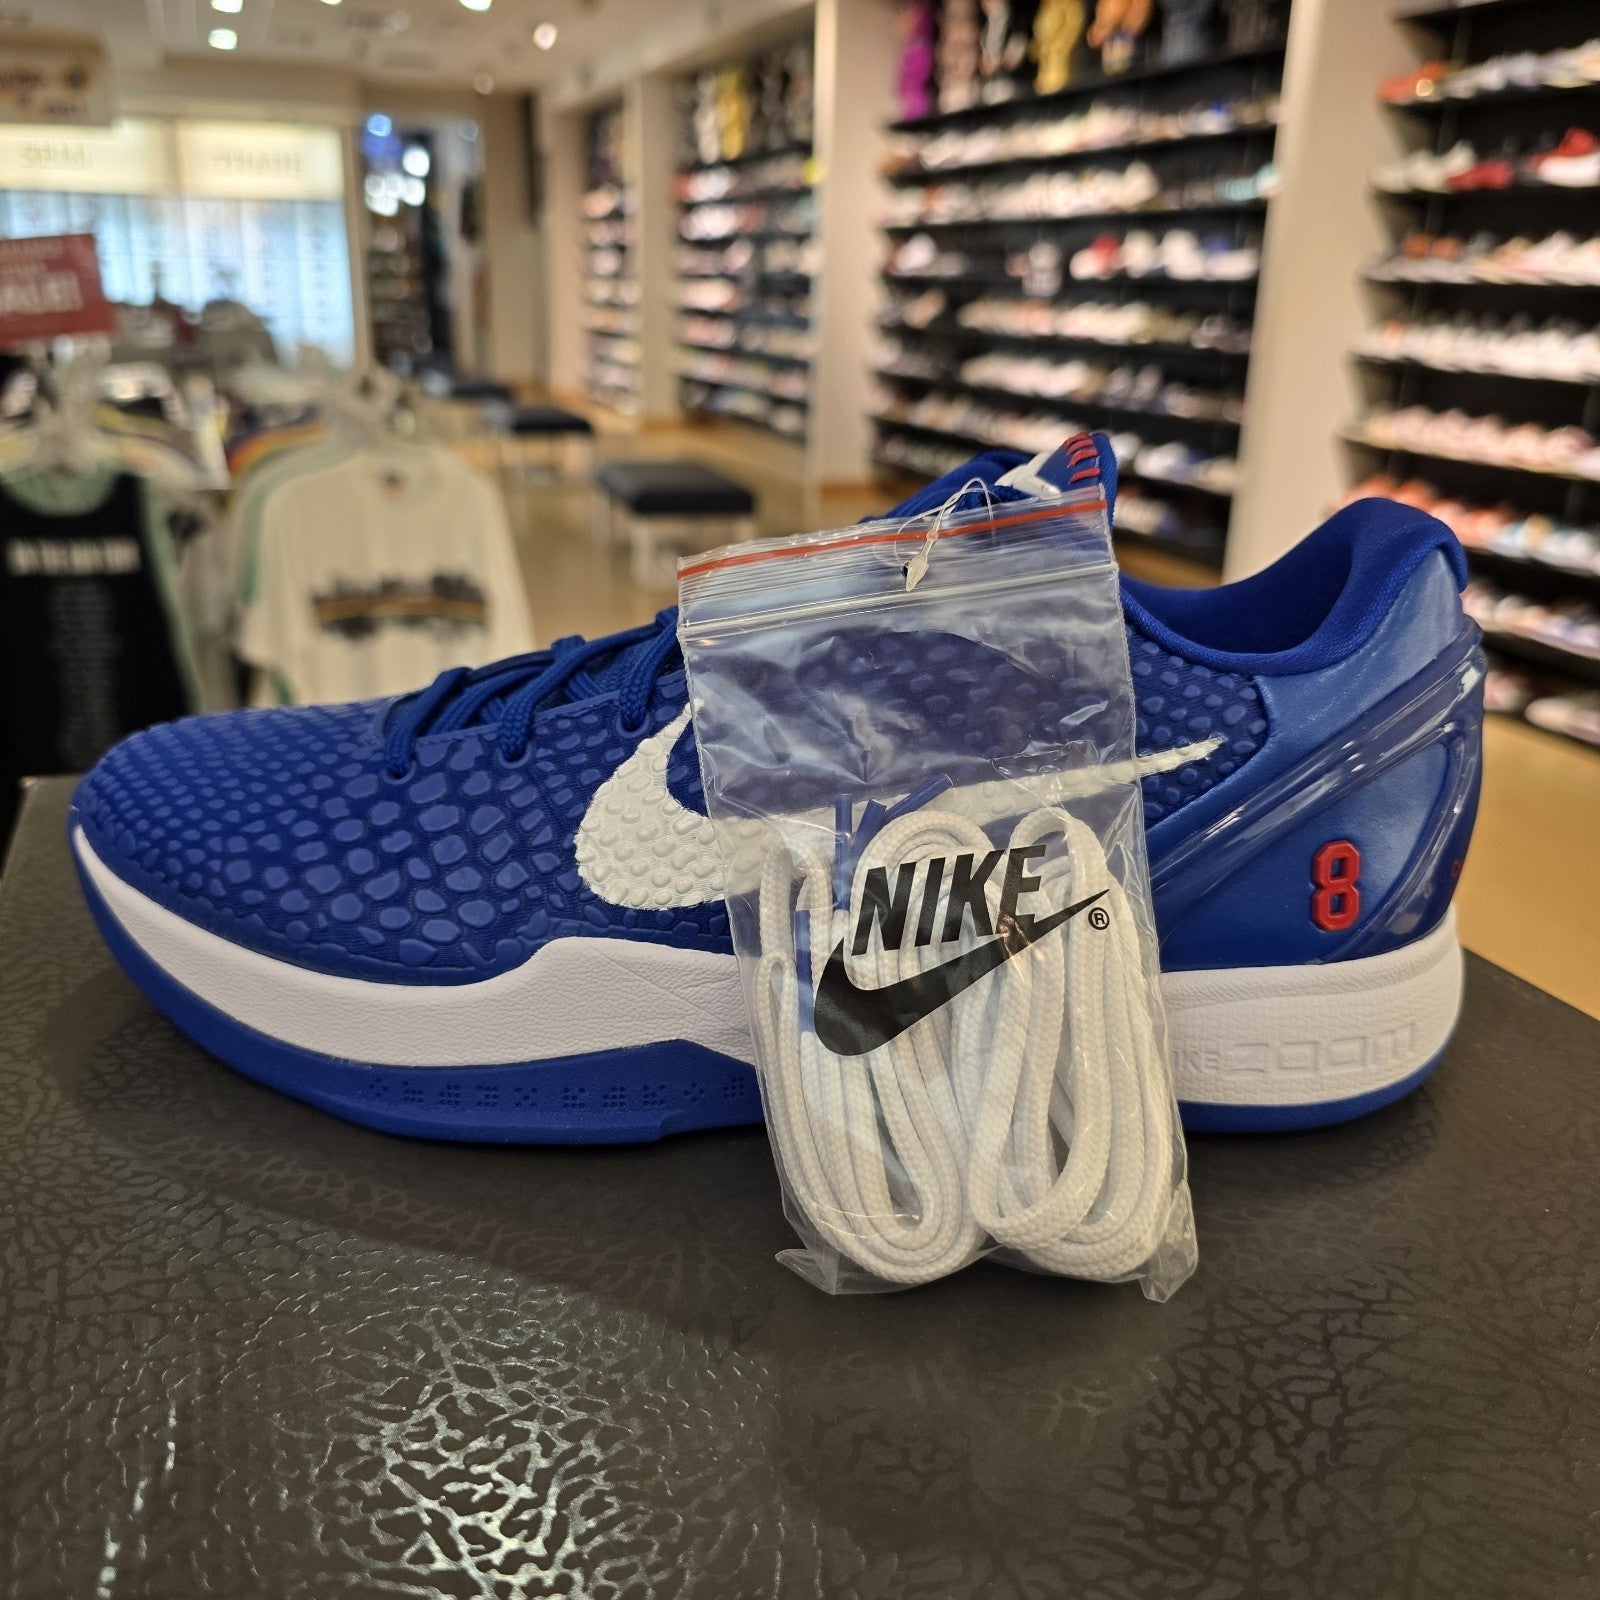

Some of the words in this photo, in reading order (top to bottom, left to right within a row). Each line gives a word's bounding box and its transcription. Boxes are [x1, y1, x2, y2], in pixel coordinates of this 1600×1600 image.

[852, 845, 1046, 956] NIKE
[1312, 840, 1360, 932] 8
[1171, 1048, 1221, 1074] IKE
